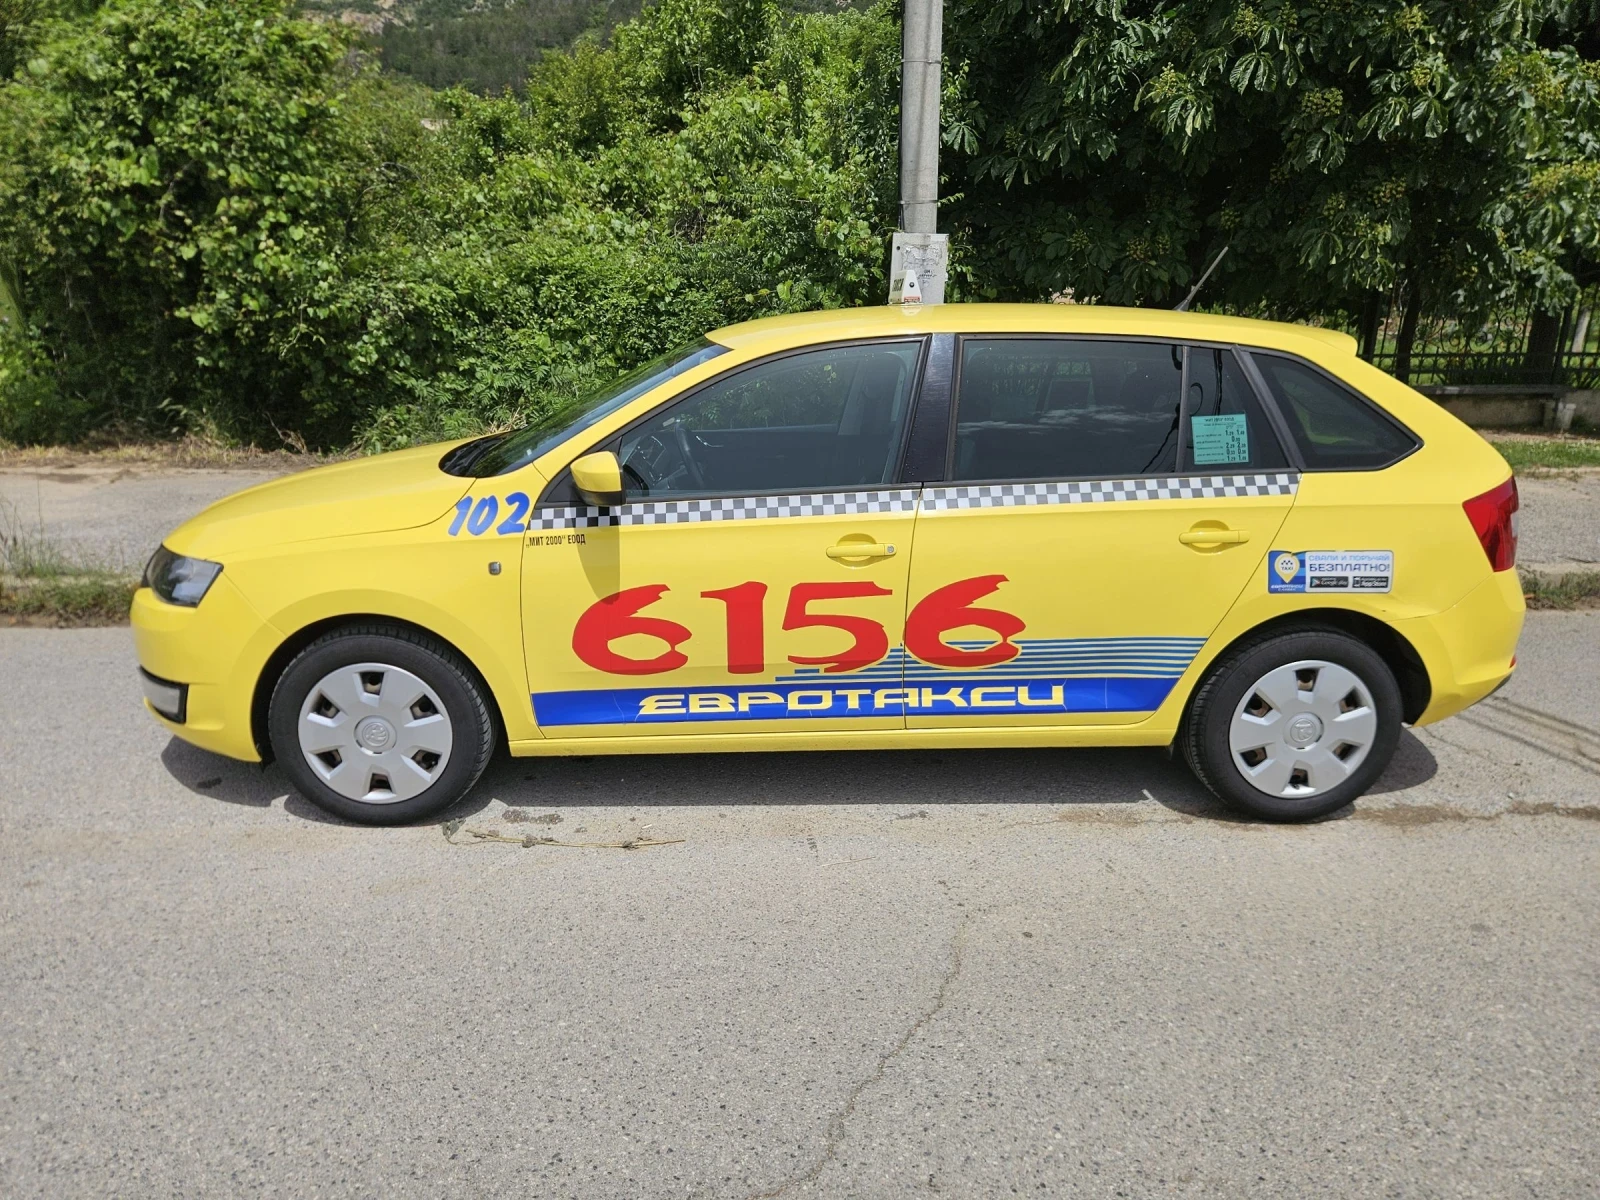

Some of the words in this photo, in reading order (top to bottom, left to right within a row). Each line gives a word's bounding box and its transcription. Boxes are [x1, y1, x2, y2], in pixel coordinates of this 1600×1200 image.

[448, 492, 530, 536] 102
[568, 534, 586, 545] ЕООД
[1309, 563, 1390, 572] БЕЗПЛАТНО!
[572, 575, 1025, 674] 6156
[637, 684, 1065, 716] ЕВРОТАКСИ
